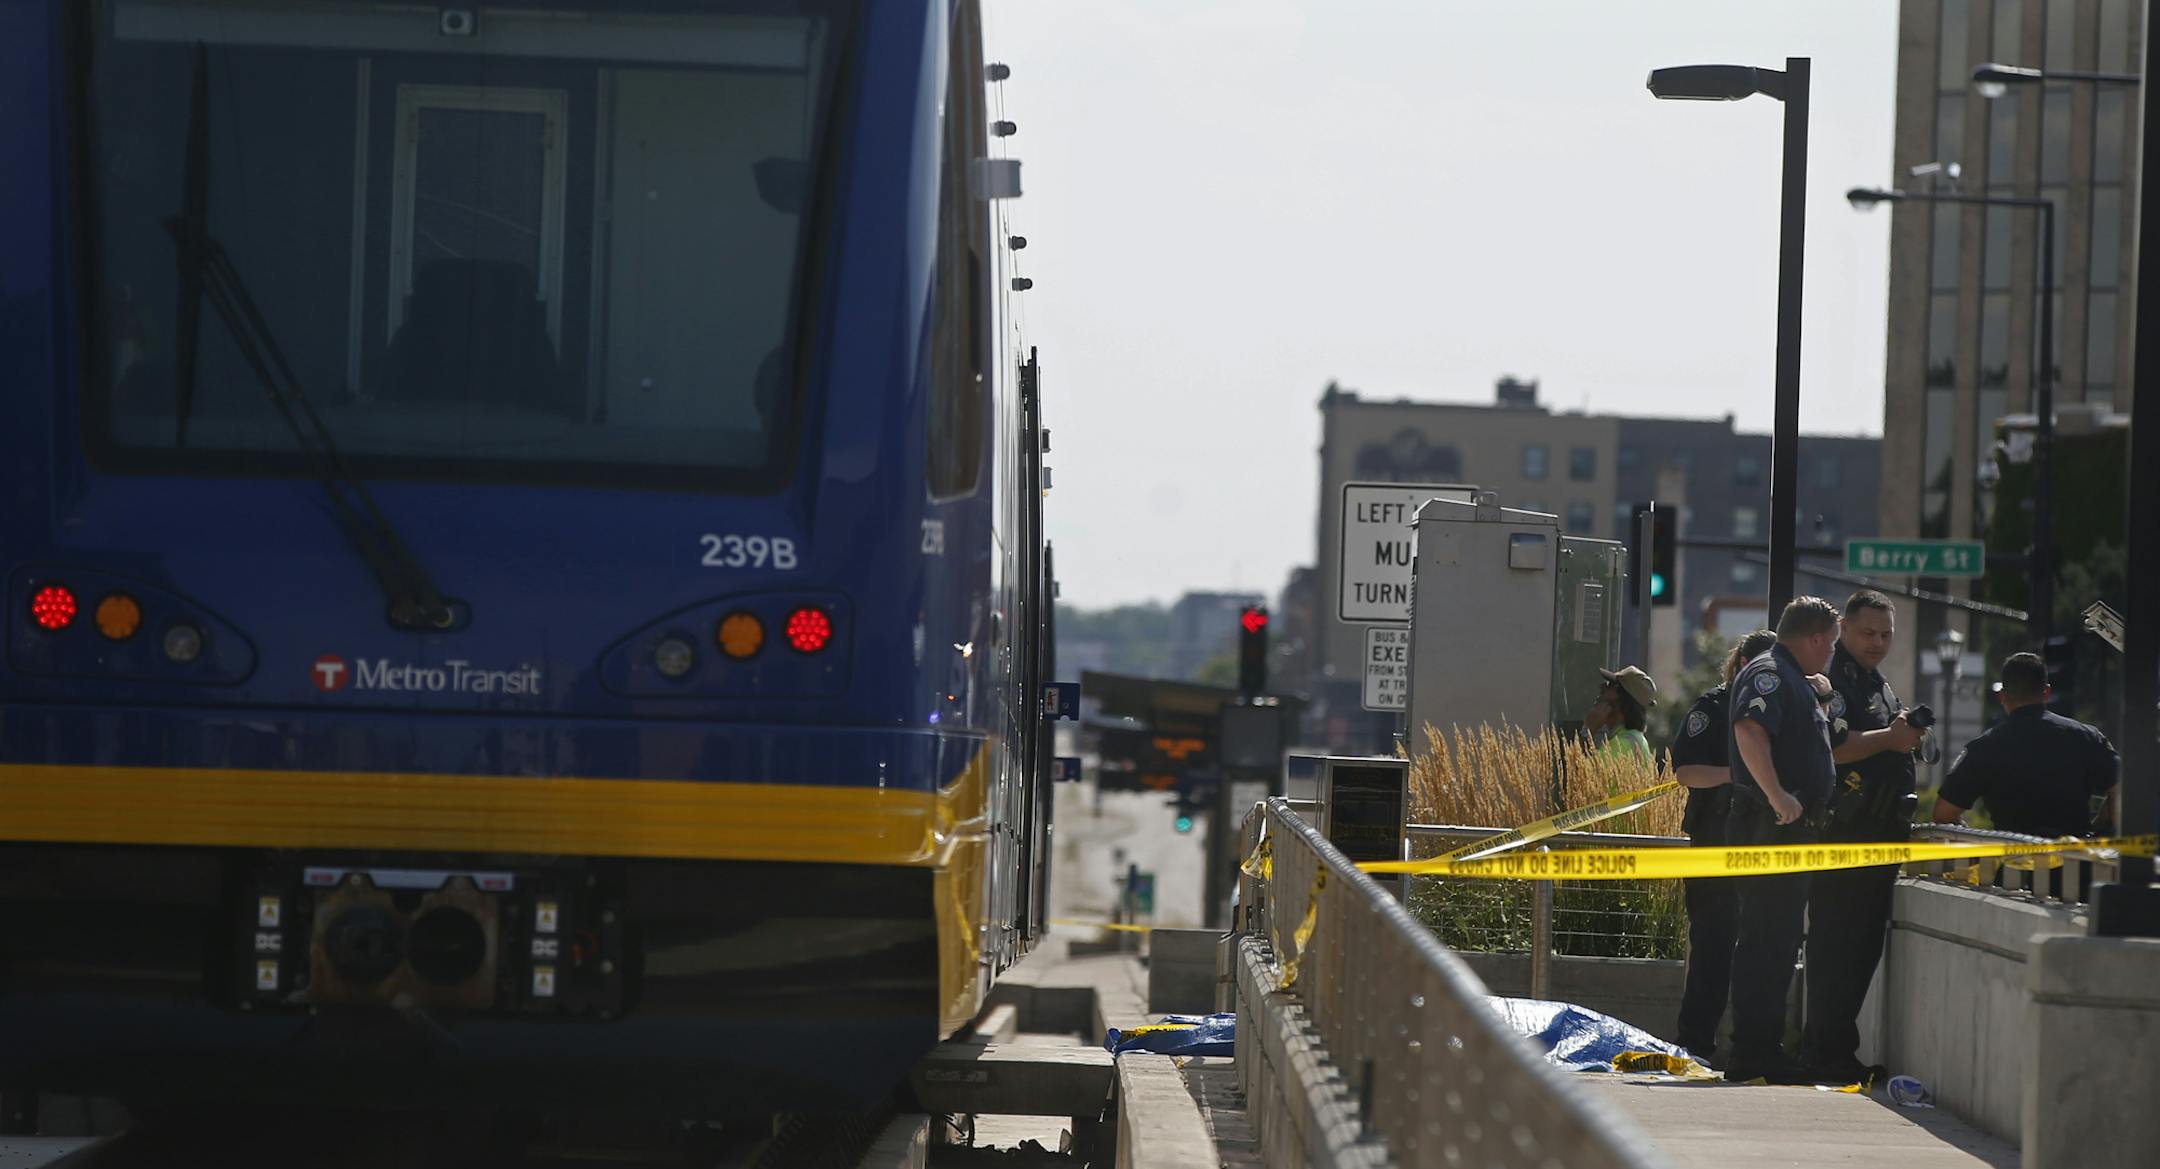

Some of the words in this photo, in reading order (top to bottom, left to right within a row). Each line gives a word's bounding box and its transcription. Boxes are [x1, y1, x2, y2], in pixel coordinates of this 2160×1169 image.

[1357, 502, 1405, 523] LEFT
[700, 533, 798, 570] 239B
[1375, 540, 1411, 566] MU
[1859, 546, 1929, 572] Berry
[1943, 547, 1969, 568] St
[1354, 582, 1407, 604] TURN
[1375, 631, 1396, 643] BUS
[1372, 646, 1405, 662] EXE
[355, 658, 445, 690] Metro
[446, 660, 542, 694] Transit
[1368, 664, 1394, 676] FROM
[1394, 680, 1406, 691] TR
